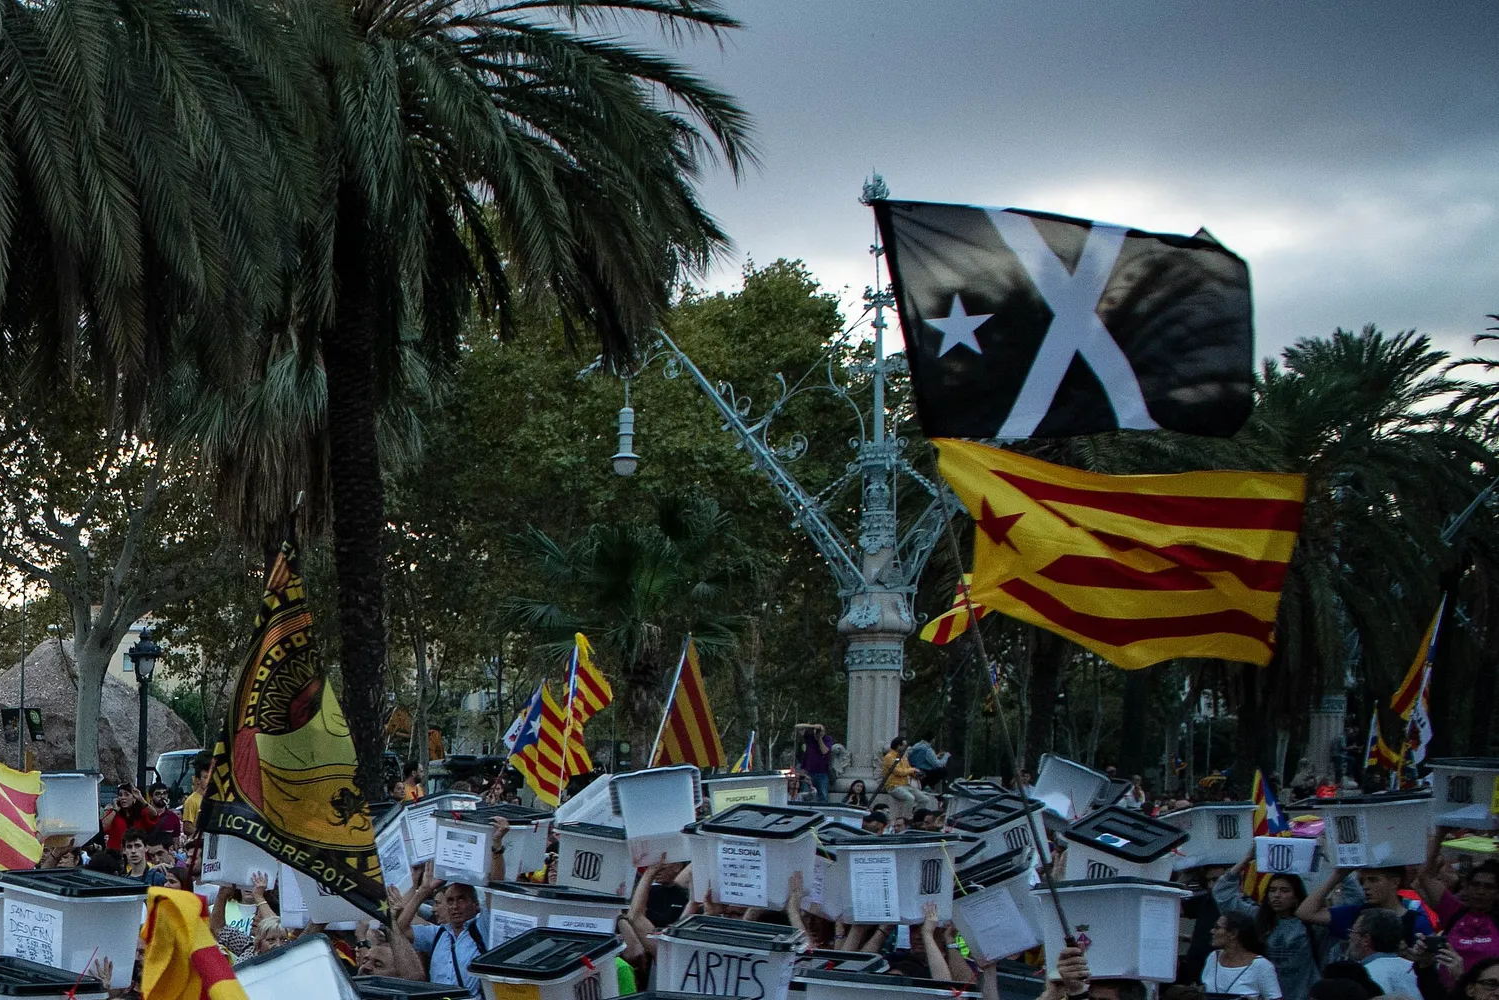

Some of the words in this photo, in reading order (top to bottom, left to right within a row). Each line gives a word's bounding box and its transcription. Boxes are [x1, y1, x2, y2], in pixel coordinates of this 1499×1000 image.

[722, 847, 761, 857] SOLSONA
[310, 860, 358, 892] 2017
[10, 904, 33, 917] SANT
[680, 949, 769, 1000] ARTÉS
